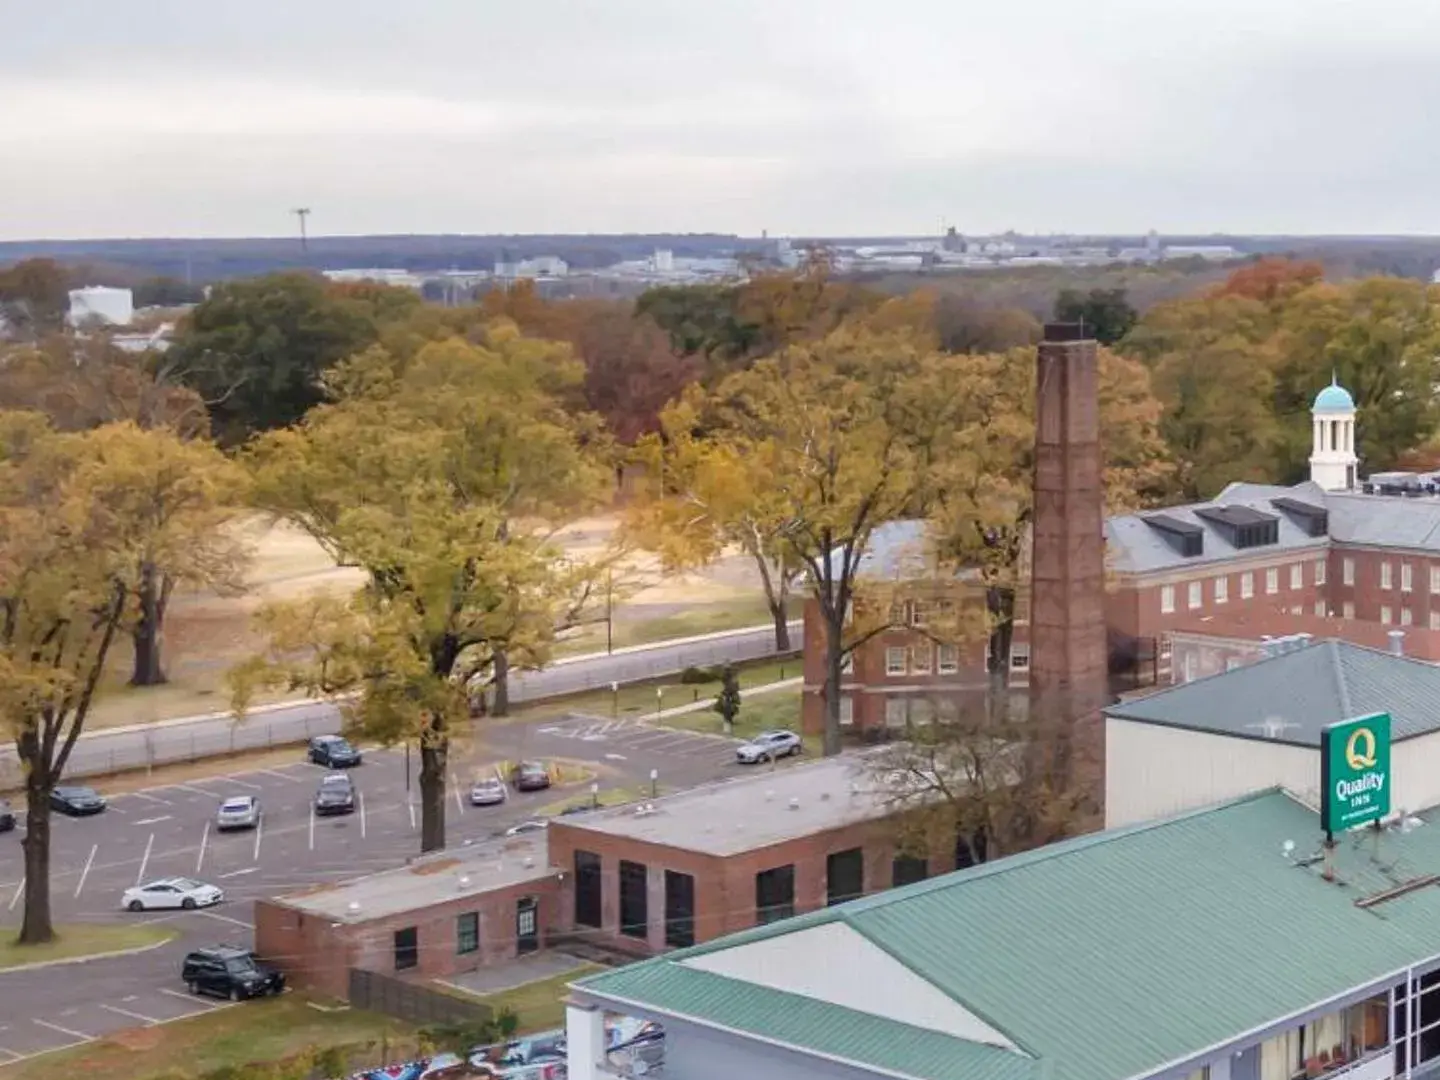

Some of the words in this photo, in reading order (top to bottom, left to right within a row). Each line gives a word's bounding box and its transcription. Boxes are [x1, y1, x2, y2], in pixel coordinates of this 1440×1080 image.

[1345, 727, 1377, 770] Q
[1336, 771, 1385, 802] Quality
[1351, 793, 1371, 807] INN
